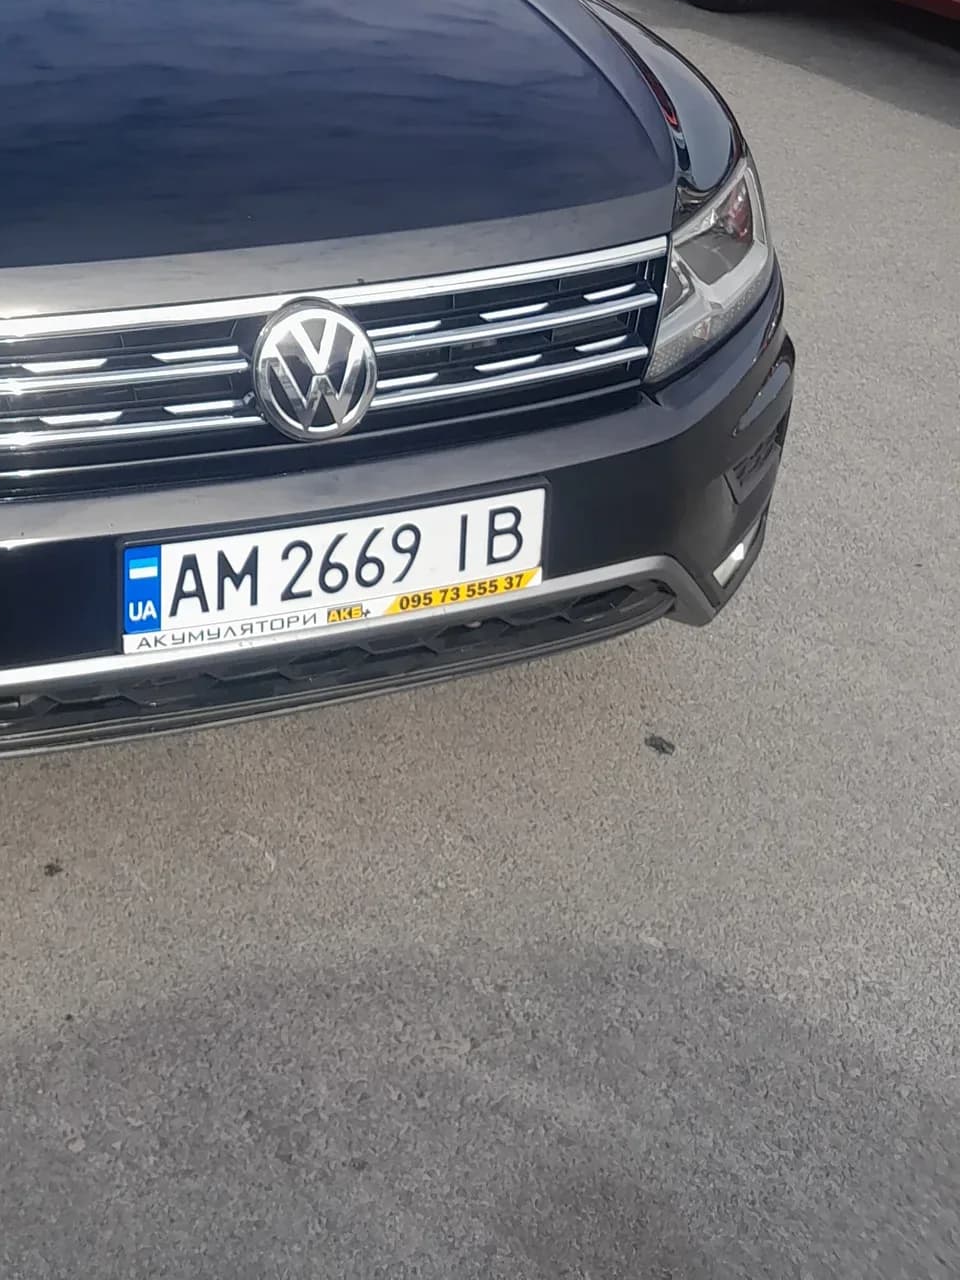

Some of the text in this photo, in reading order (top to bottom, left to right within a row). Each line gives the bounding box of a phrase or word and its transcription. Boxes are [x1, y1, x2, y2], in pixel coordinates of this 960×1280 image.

[168, 505, 524, 618] AM 2669 IB
[128, 600, 158, 622] UA
[136, 612, 318, 650] АКУМУЛЯТОРИ
[399, 591, 433, 611] 095
[439, 586, 461, 603] 73
[466, 578, 499, 598] 555
[503, 573, 525, 590] 37
